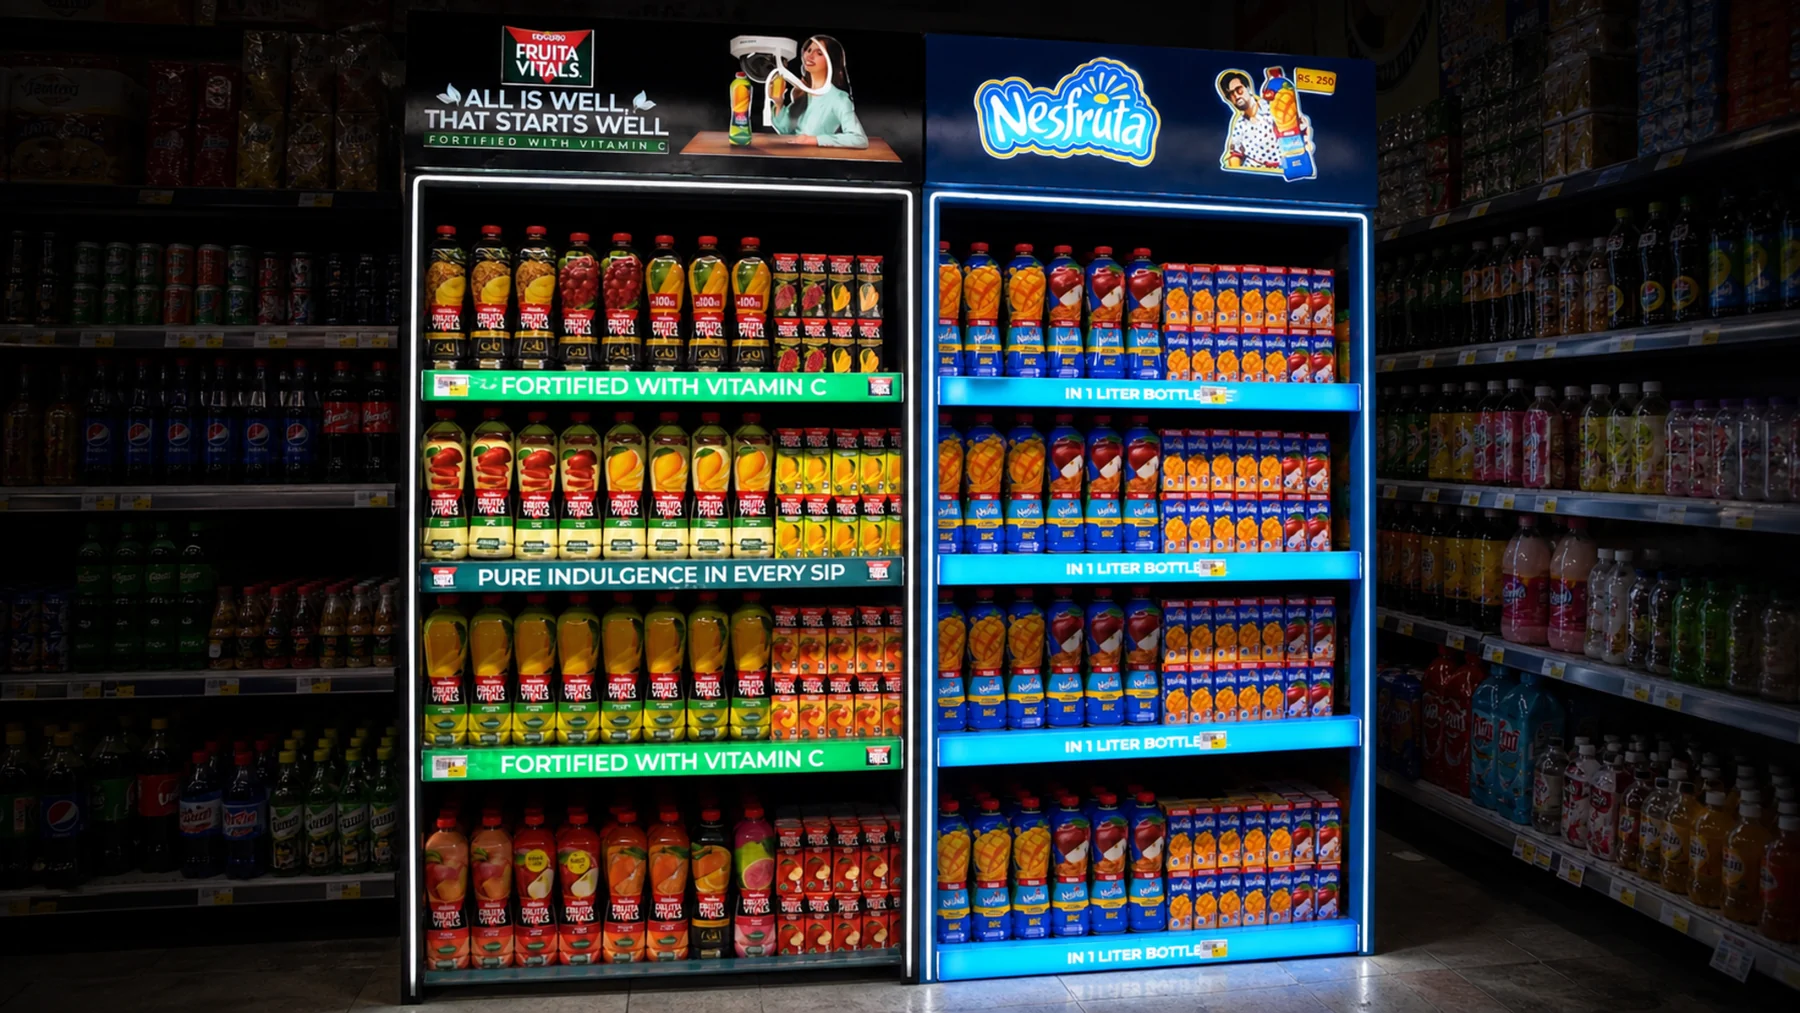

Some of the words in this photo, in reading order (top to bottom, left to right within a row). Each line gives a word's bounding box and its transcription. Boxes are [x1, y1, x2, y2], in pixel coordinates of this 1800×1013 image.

[516, 43, 579, 61] FRUITA
[1297, 74, 1314, 84] RS.
[1316, 76, 1335, 86] 250
[464, 89, 513, 109] ALL
[521, 90, 543, 110] IS
[549, 91, 629, 116] WELL,
[424, 109, 490, 130] THAT
[495, 111, 588, 134] STARTS
[595, 115, 669, 136] WELL
[991, 86, 1148, 150] Nesfruta
[428, 135, 517, 147] FORTIFIED
[528, 138, 569, 148] WITH
[579, 140, 647, 150] VITAMIN
[658, 142, 666, 151] C
[501, 376, 629, 395] FORTIFIED
[635, 377, 699, 395] WITH
[705, 378, 803, 396] VITAMIN
[810, 379, 827, 396] C
[1065, 387, 1082, 399] IN
[1086, 388, 1092, 399] 1
[1096, 388, 1140, 400] LITER
[478, 569, 541, 586] PURE
[548, 567, 697, 585] INDULGENCE
[705, 566, 727, 583] IN
[734, 565, 806, 582] EVERY
[811, 564, 845, 580] SIP
[1066, 563, 1083, 575] IN
[1086, 563, 1093, 574] 1
[1097, 562, 1140, 574] LITER
[1065, 741, 1082, 753] IN
[1086, 740, 1092, 752] 1
[1097, 739, 1140, 751] LITER
[501, 754, 628, 773] FORTIFIED
[634, 753, 697, 771] WITH
[704, 750, 801, 769] VITAMIN
[808, 749, 824, 766] C
[1067, 951, 1084, 964] IN
[1088, 951, 1094, 963] 1
[1098, 949, 1142, 962] LITER
